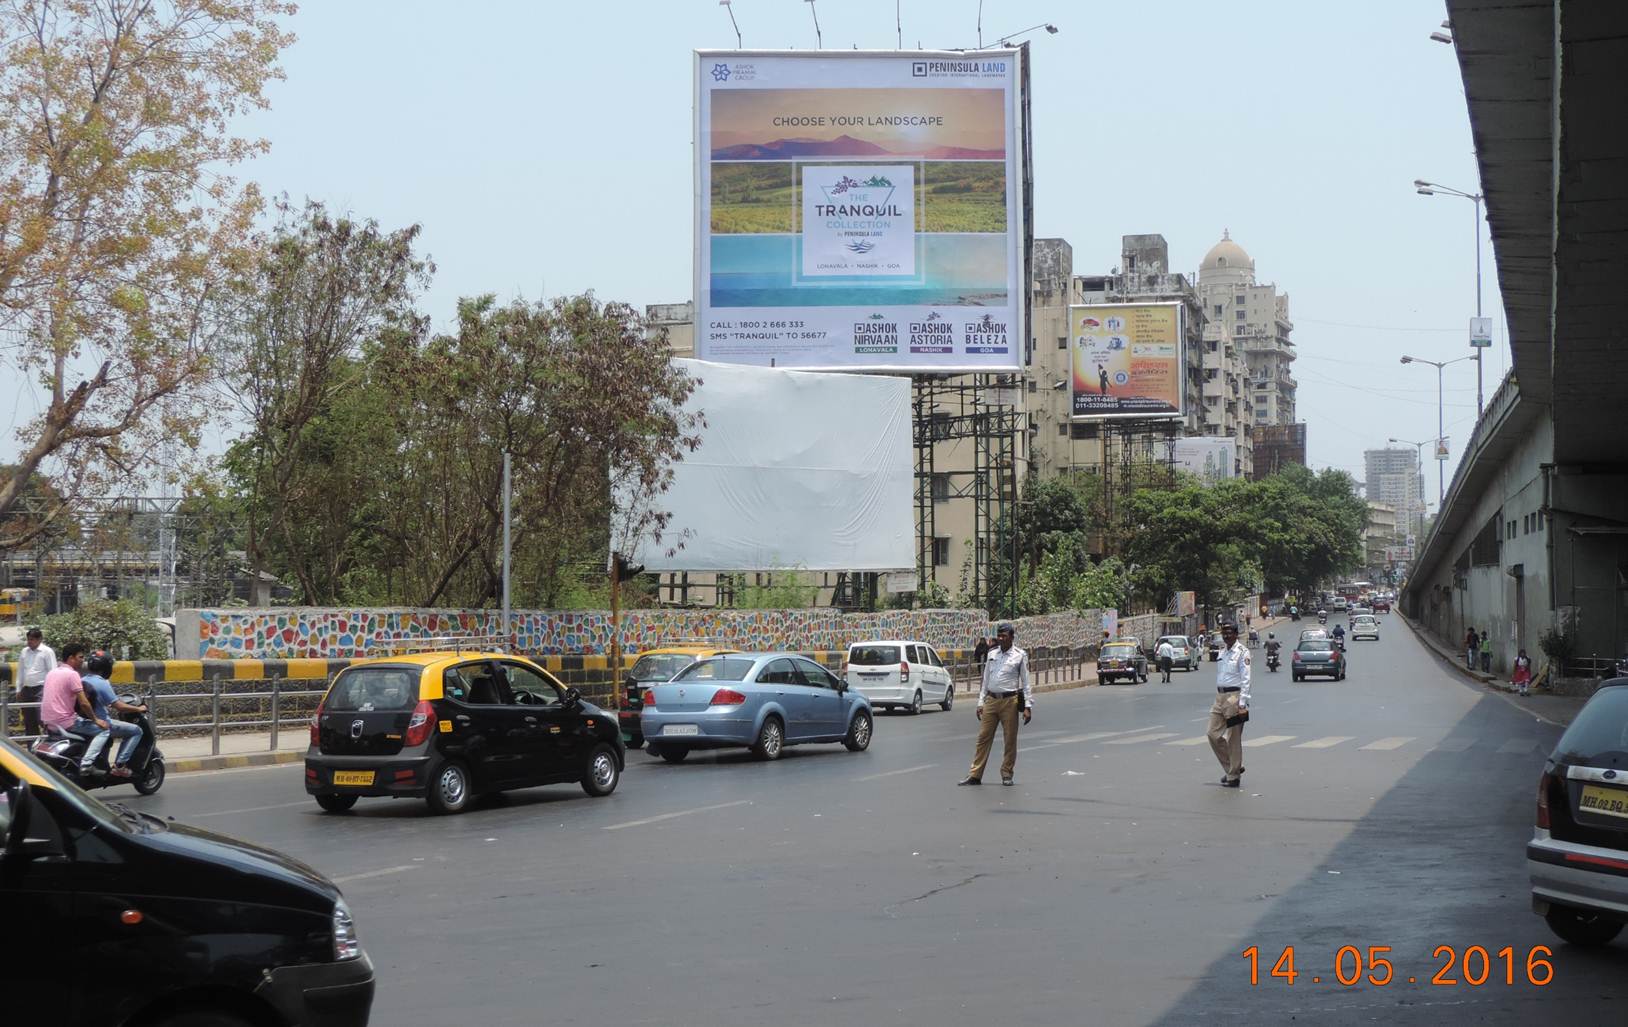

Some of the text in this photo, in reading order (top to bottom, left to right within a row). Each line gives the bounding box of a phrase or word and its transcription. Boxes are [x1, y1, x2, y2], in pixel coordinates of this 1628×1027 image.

[929, 62, 1006, 73] PENINSULA LAND
[773, 116, 943, 127] CHOOSE YOUR LANDSCAPE
[815, 204, 902, 217] TRANQUIL
[826, 221, 891, 229] COLLECTION
[740, 321, 760, 329] 1800
[789, 320, 804, 328] 333
[865, 323, 897, 334] ASHOK
[921, 323, 953, 334] ASHOK
[976, 323, 1007, 334] ASHOK
[786, 331, 798, 339] TO
[801, 331, 827, 339] 56677
[854, 335, 898, 345] NIRVAAN
[910, 335, 953, 345] ASTORIA
[965, 335, 1007, 345] BELEZA
